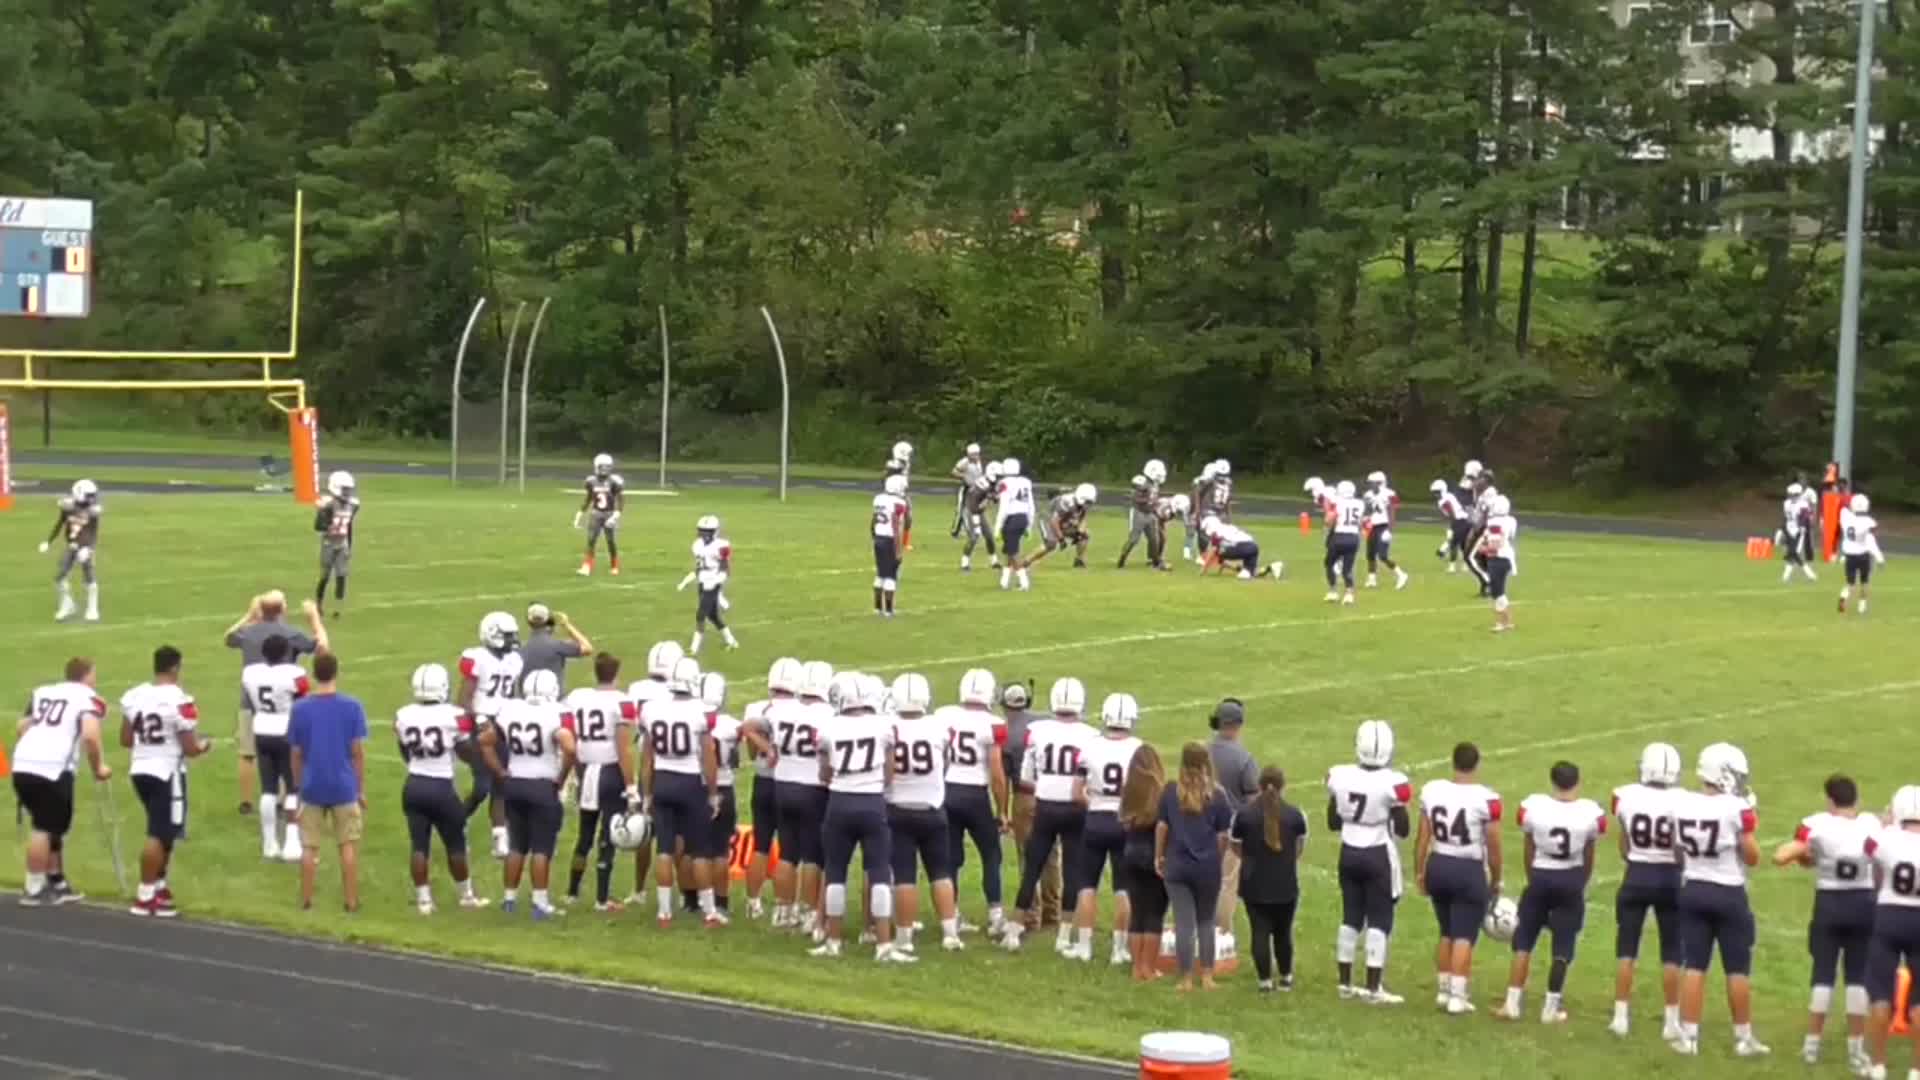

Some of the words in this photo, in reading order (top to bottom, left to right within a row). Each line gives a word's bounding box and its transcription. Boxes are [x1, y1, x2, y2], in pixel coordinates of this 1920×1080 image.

[41, 231, 86, 247] GUEST
[258, 686, 276, 714] 5
[132, 710, 165, 744] 42
[508, 722, 544, 757] 63
[577, 708, 607, 741] 12
[652, 720, 691, 757] 80
[778, 722, 817, 757] 72
[405, 726, 444, 758] 23
[835, 738, 875, 775] 77
[893, 741, 933, 775] 99
[1042, 743, 1079, 776] 10
[1102, 762, 1123, 796] 9
[1348, 791, 1367, 823] 7
[1431, 805, 1471, 846] 64
[1679, 819, 1720, 857] 57
[1547, 827, 1571, 860] 3
